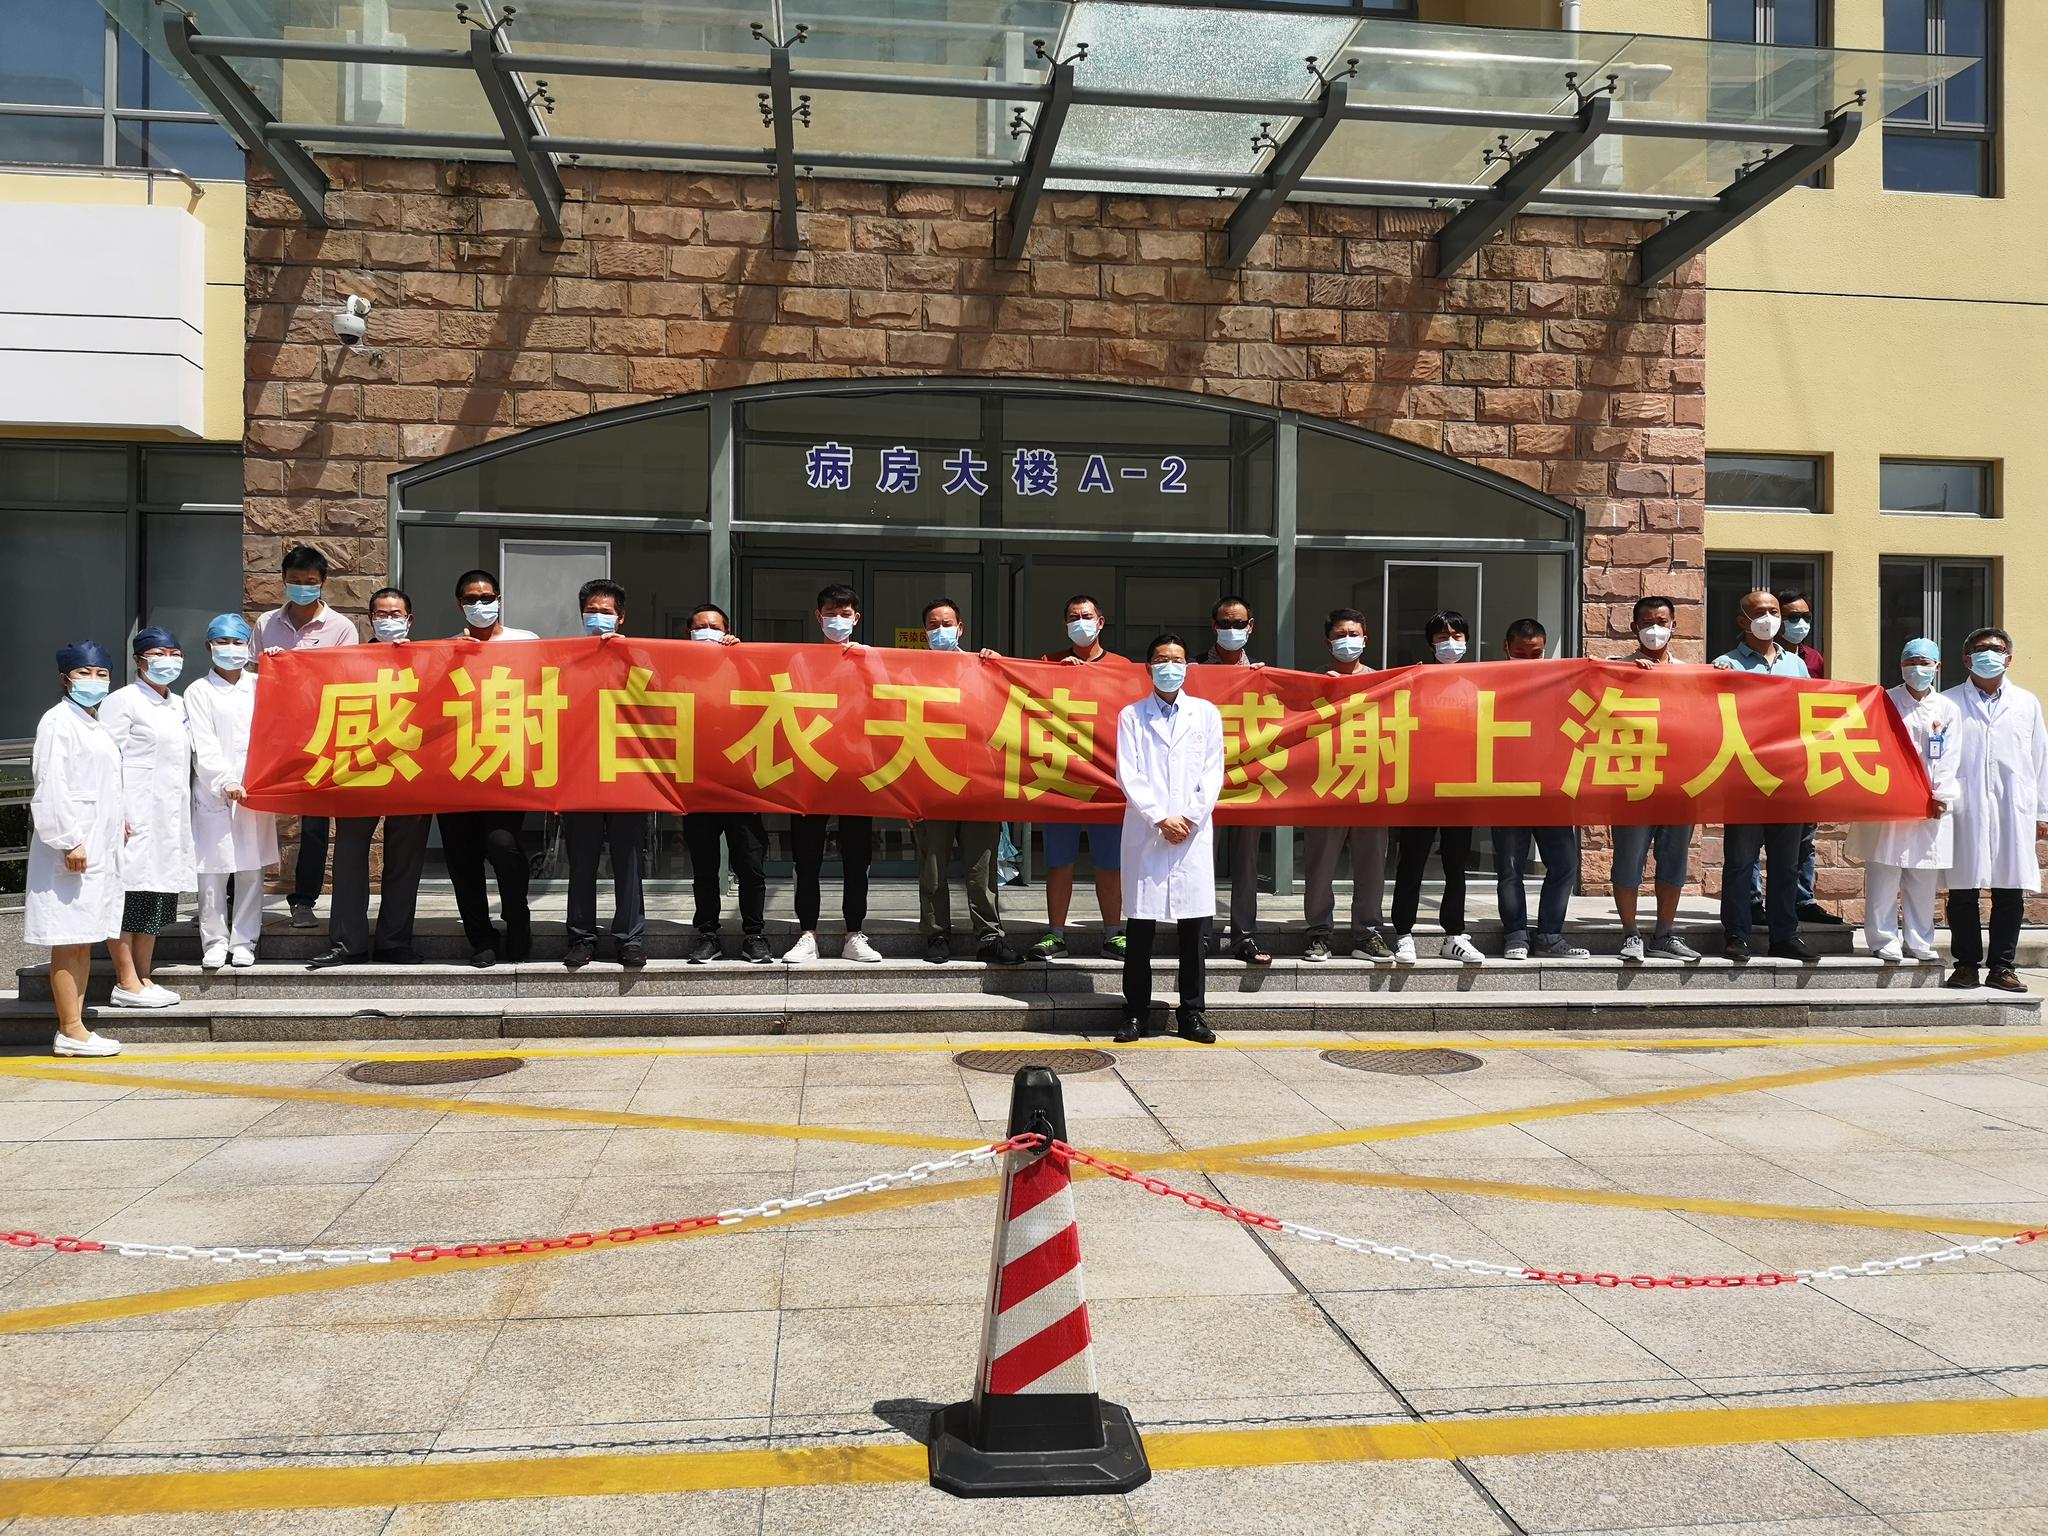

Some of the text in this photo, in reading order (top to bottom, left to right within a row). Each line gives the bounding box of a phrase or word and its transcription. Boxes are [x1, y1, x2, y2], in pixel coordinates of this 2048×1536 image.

[302, 666, 1891, 805] 感谢白衣天使 感谢上海人民
